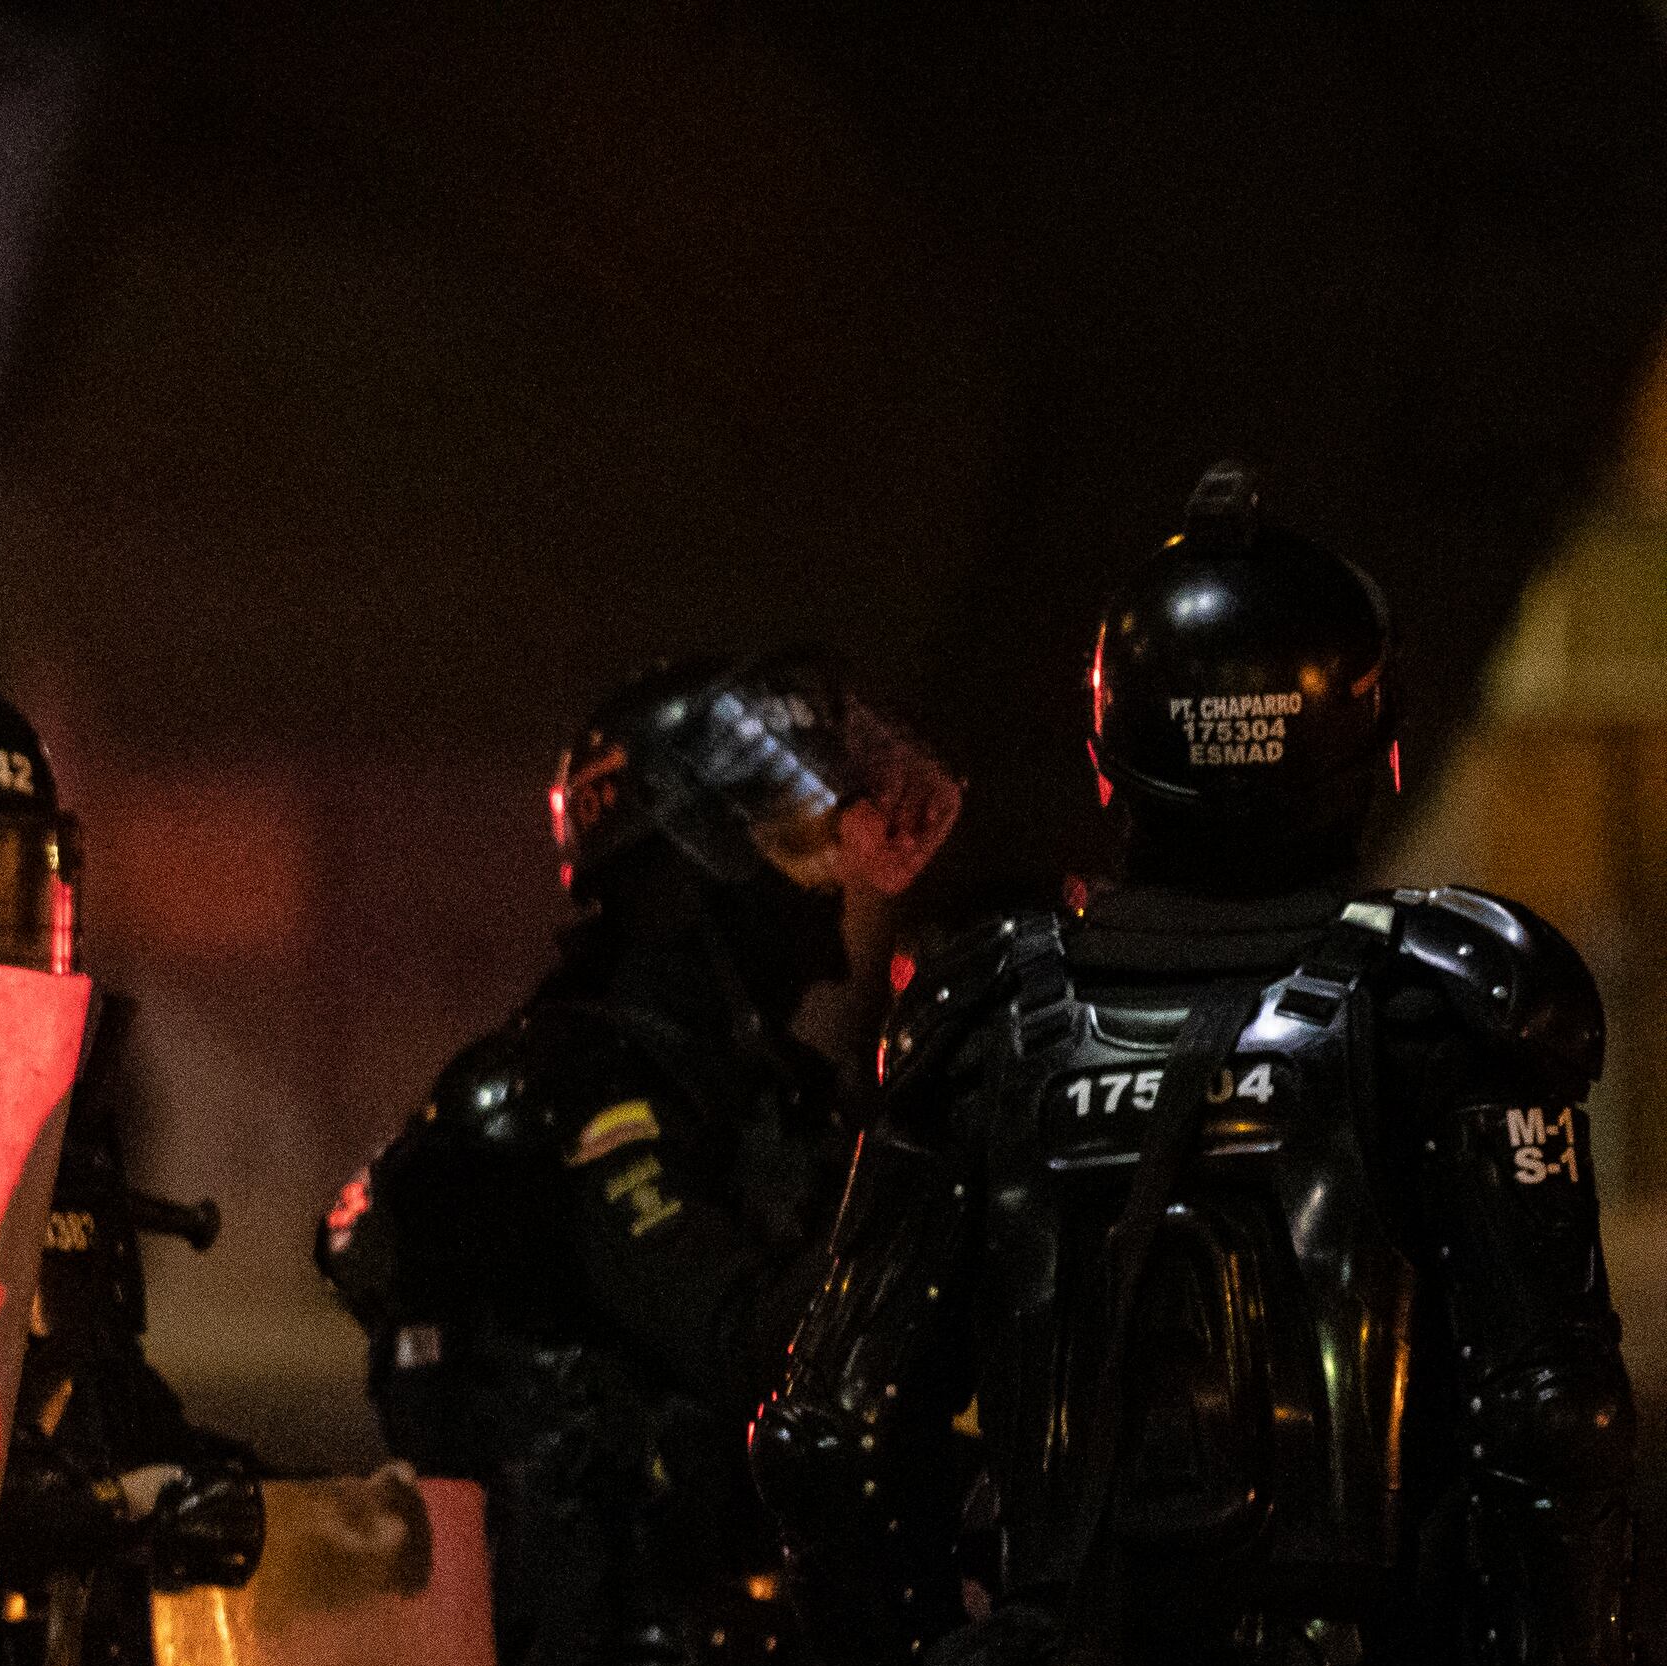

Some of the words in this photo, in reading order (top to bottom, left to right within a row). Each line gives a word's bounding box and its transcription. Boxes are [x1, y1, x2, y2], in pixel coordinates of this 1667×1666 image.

[1200, 691, 1303, 720] CHAPARRO
[1182, 717, 1287, 742] 175304
[1190, 740, 1285, 766] ESMAD
[1505, 1105, 1575, 1148] M-1
[1513, 1145, 1580, 1185] S-1
